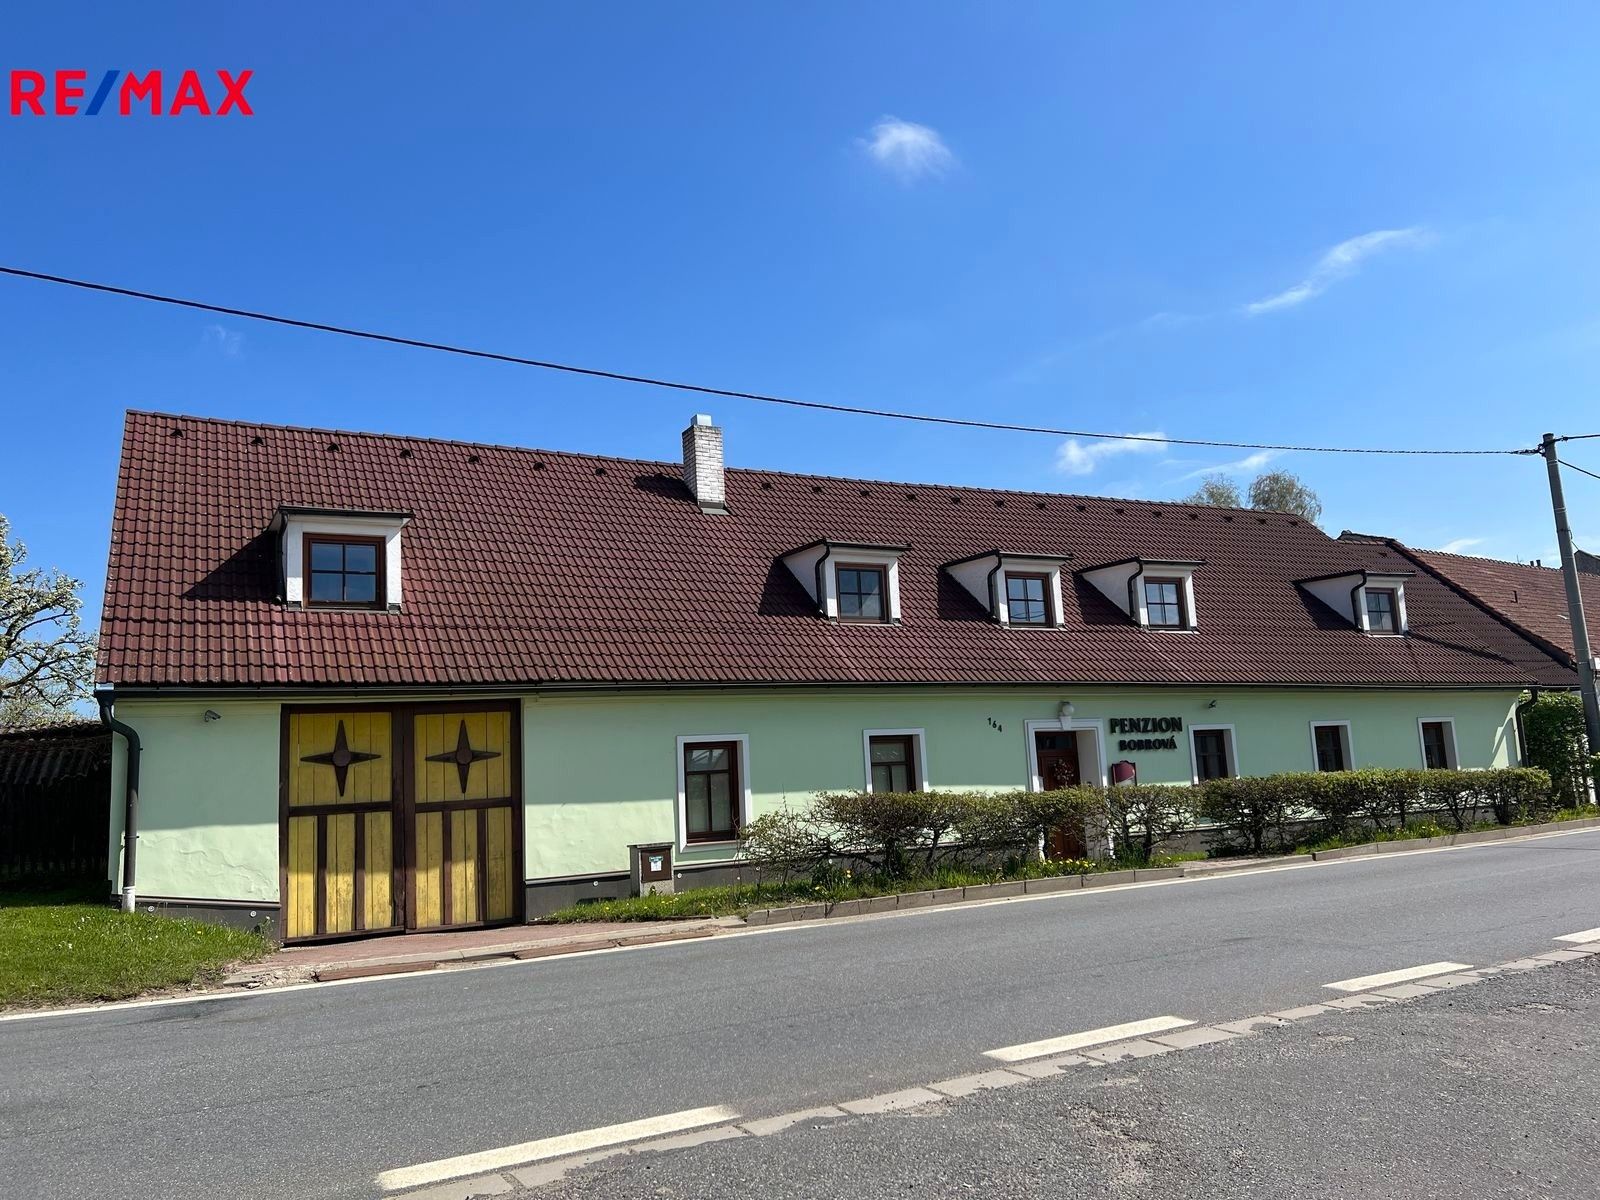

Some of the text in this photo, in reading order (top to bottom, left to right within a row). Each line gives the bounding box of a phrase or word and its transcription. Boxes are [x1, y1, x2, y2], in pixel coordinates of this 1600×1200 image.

[987, 717, 1002, 733] 164
[1110, 717, 1183, 733] PENZION
[1119, 735, 1177, 751] BOBROVÁ
